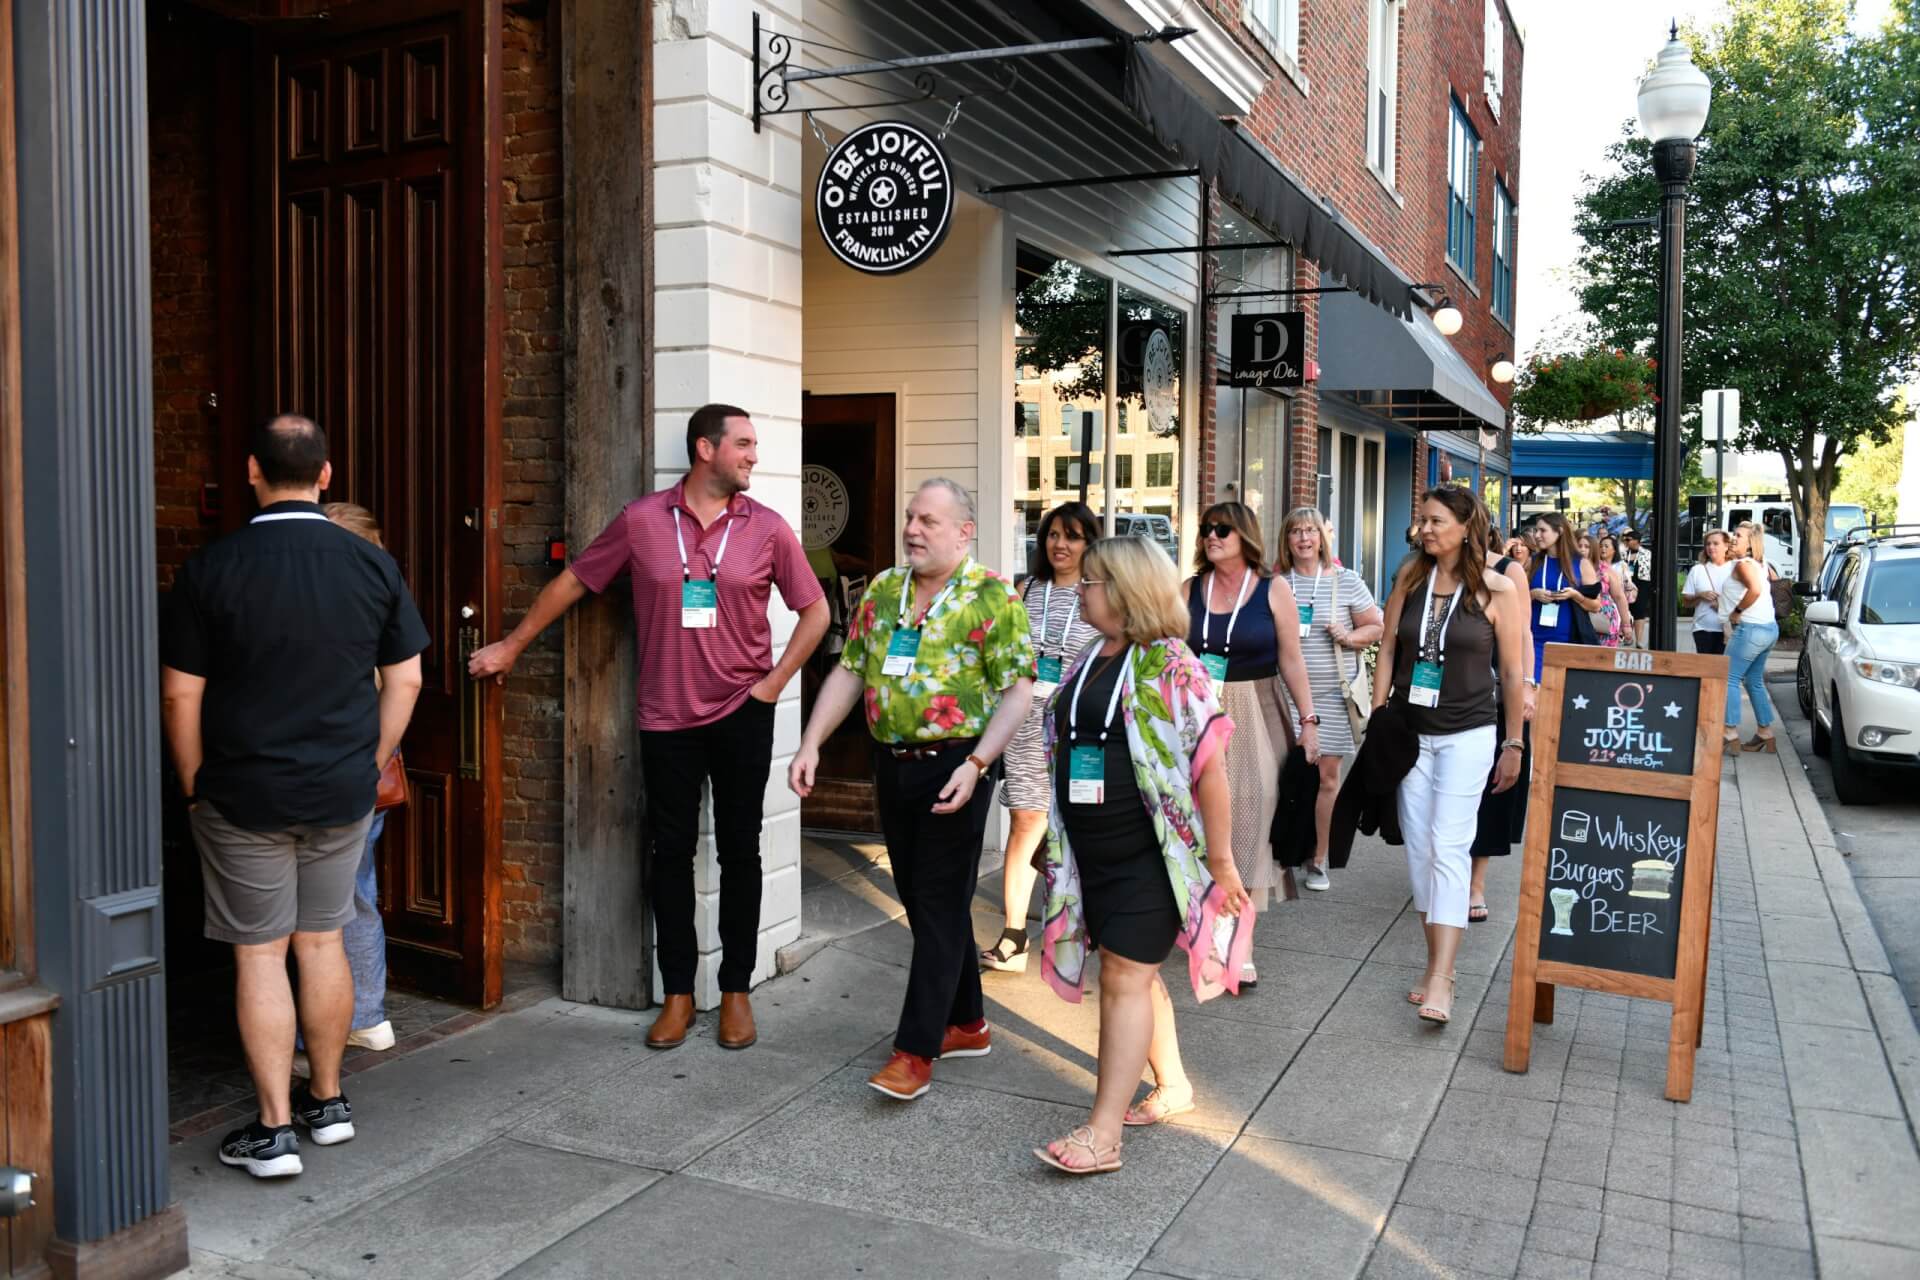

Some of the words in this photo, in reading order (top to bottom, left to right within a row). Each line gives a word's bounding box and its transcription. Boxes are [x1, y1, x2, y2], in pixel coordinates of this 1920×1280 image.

[832, 144, 864, 181] BE
[865, 131, 942, 200] JOYFUL
[825, 179, 844, 208] O'
[848, 162, 877, 201] WHISKEY
[879, 158, 889, 171] &
[890, 161, 918, 196] BURGERS
[838, 208, 928, 224] ESTABLISHED
[907, 224, 931, 248] TN
[1235, 368, 1272, 386] imago
[1273, 361, 1299, 379] Dei
[802, 471, 843, 510] JOYFUL
[824, 523, 837, 537] TN
[1614, 651, 1653, 672] BAR
[1615, 682, 1653, 710] O'
[1607, 706, 1645, 729] BE
[1583, 728, 1673, 753] JOYFUL
[1548, 847, 1624, 899] Burgers
[1590, 898, 1664, 935] BEER
